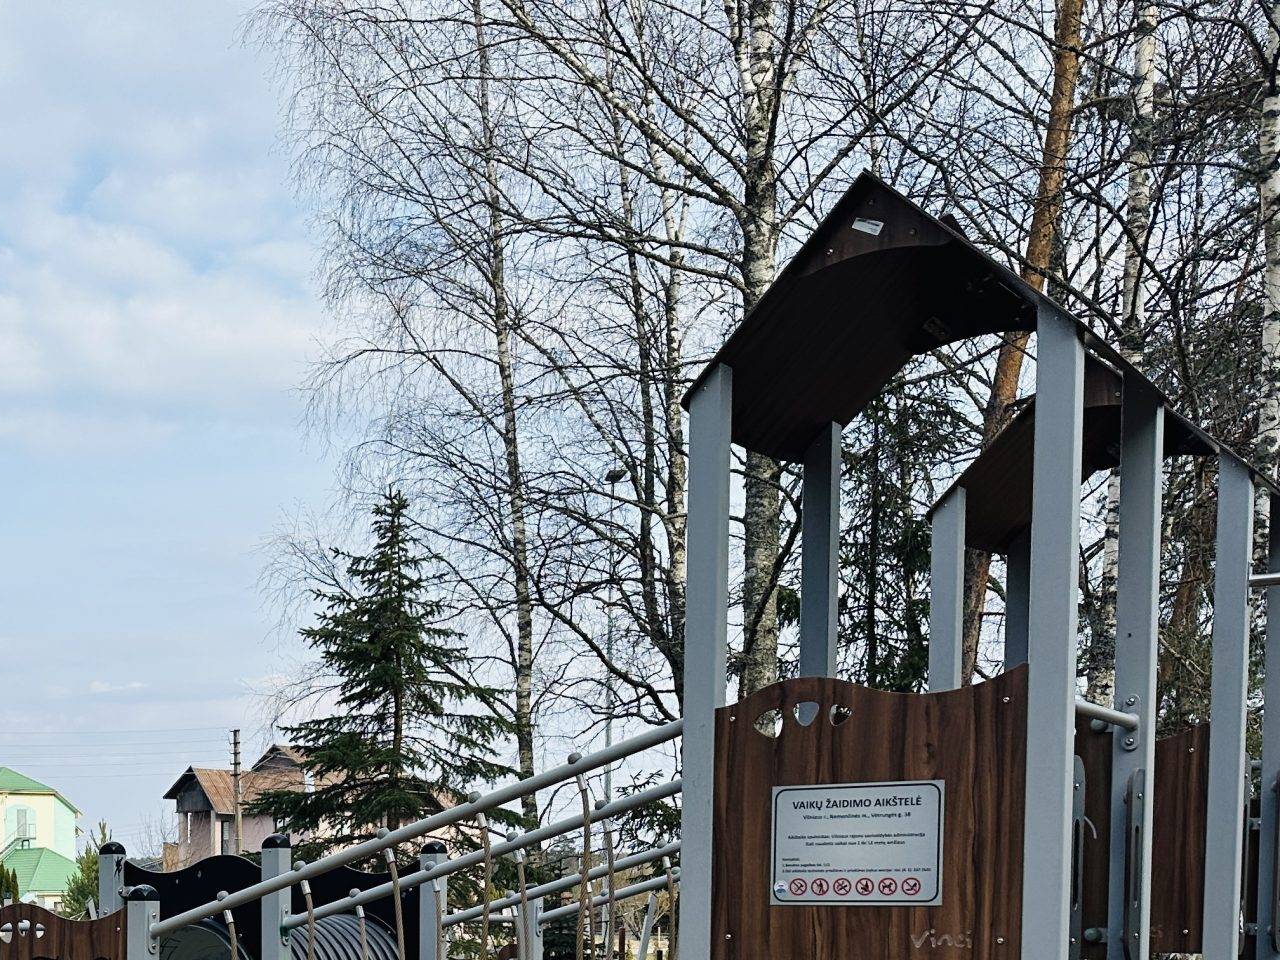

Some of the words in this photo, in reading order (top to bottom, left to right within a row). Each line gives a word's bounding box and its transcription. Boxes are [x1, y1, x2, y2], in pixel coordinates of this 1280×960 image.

[792, 800, 823, 811] VAIKŲ
[825, 797, 872, 809] ŽAIDIMO
[873, 795, 922, 807] AIKŠTELĖ
